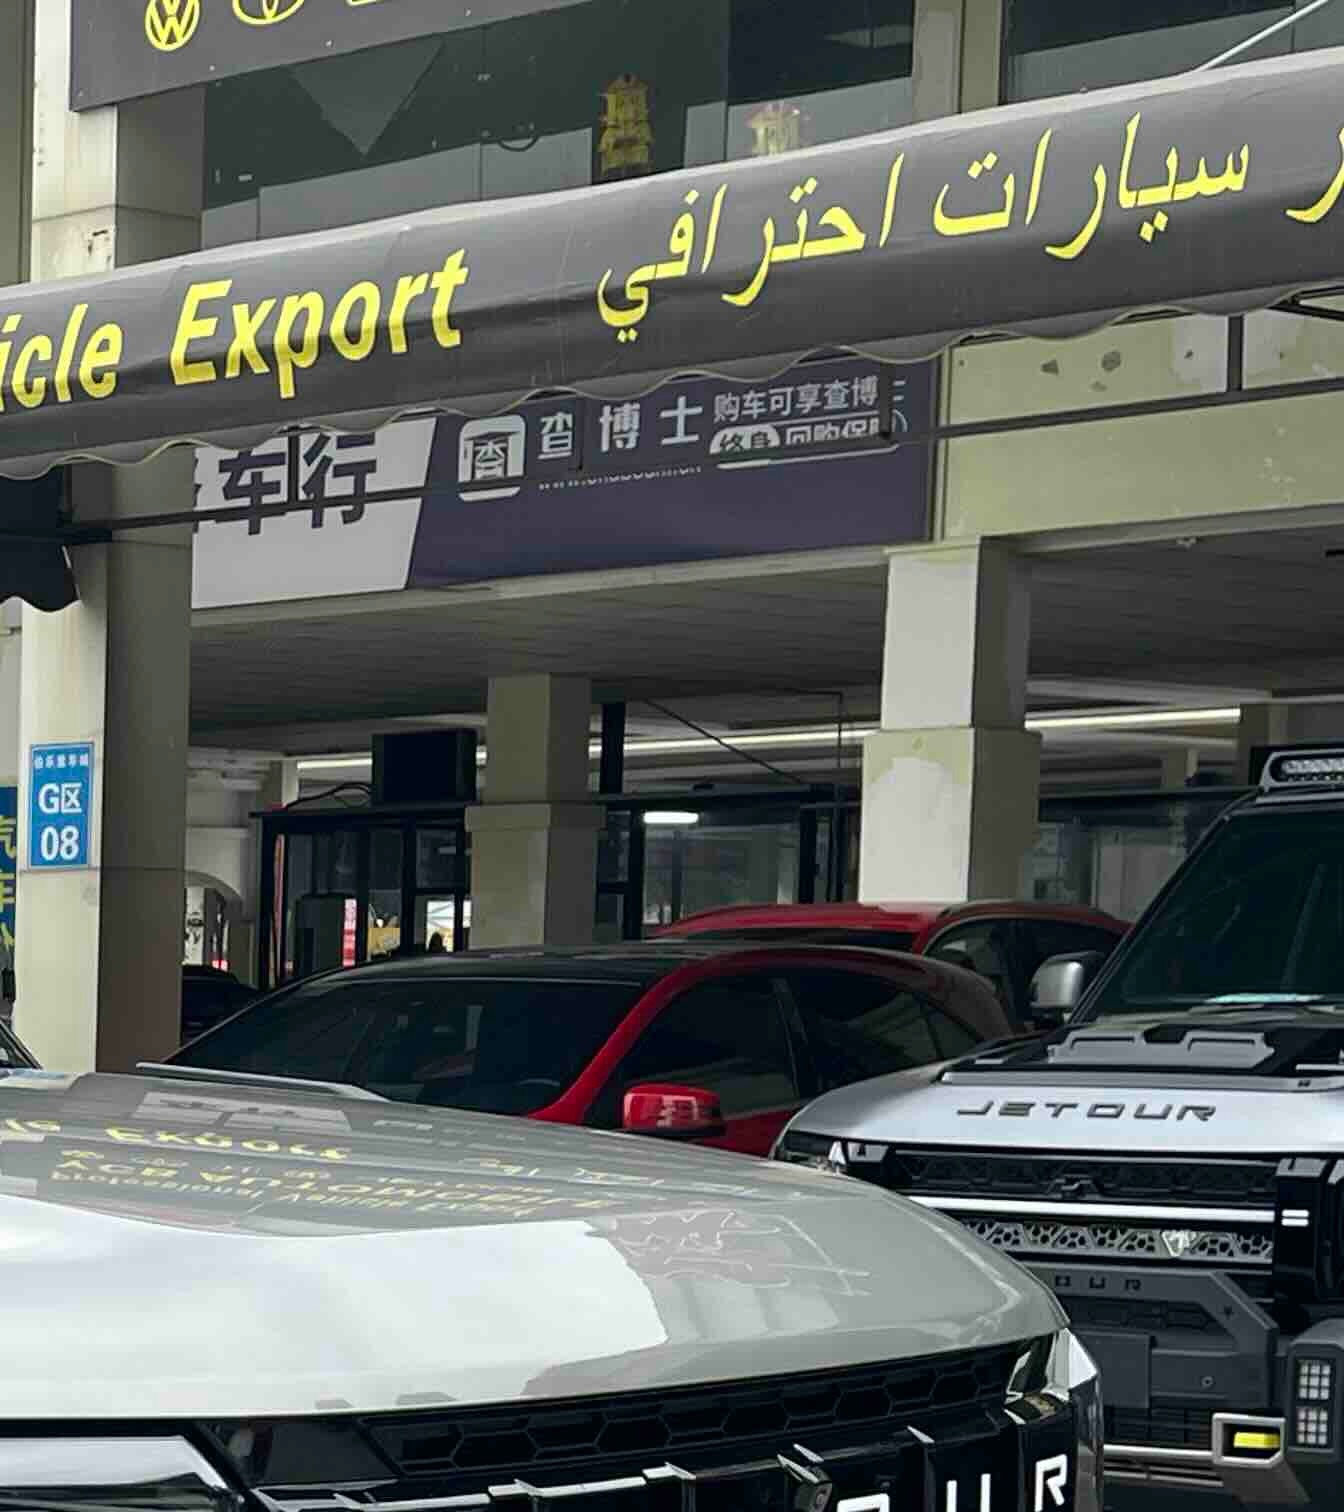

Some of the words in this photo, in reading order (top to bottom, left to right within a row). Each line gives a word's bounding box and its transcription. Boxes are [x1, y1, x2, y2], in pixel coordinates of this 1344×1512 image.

[933, 112, 1250, 260] سيارات
[597, 152, 904, 342] احترافي
[168, 248, 470, 400] Export
[537, 395, 704, 461] 查博士
[713, 375, 906, 423] 购车可享查博
[194, 432, 378, 529] 车行
[37, 782, 82, 814] G区
[40, 826, 80, 861] 08
[956, 1099, 1217, 1122] JETOUR
